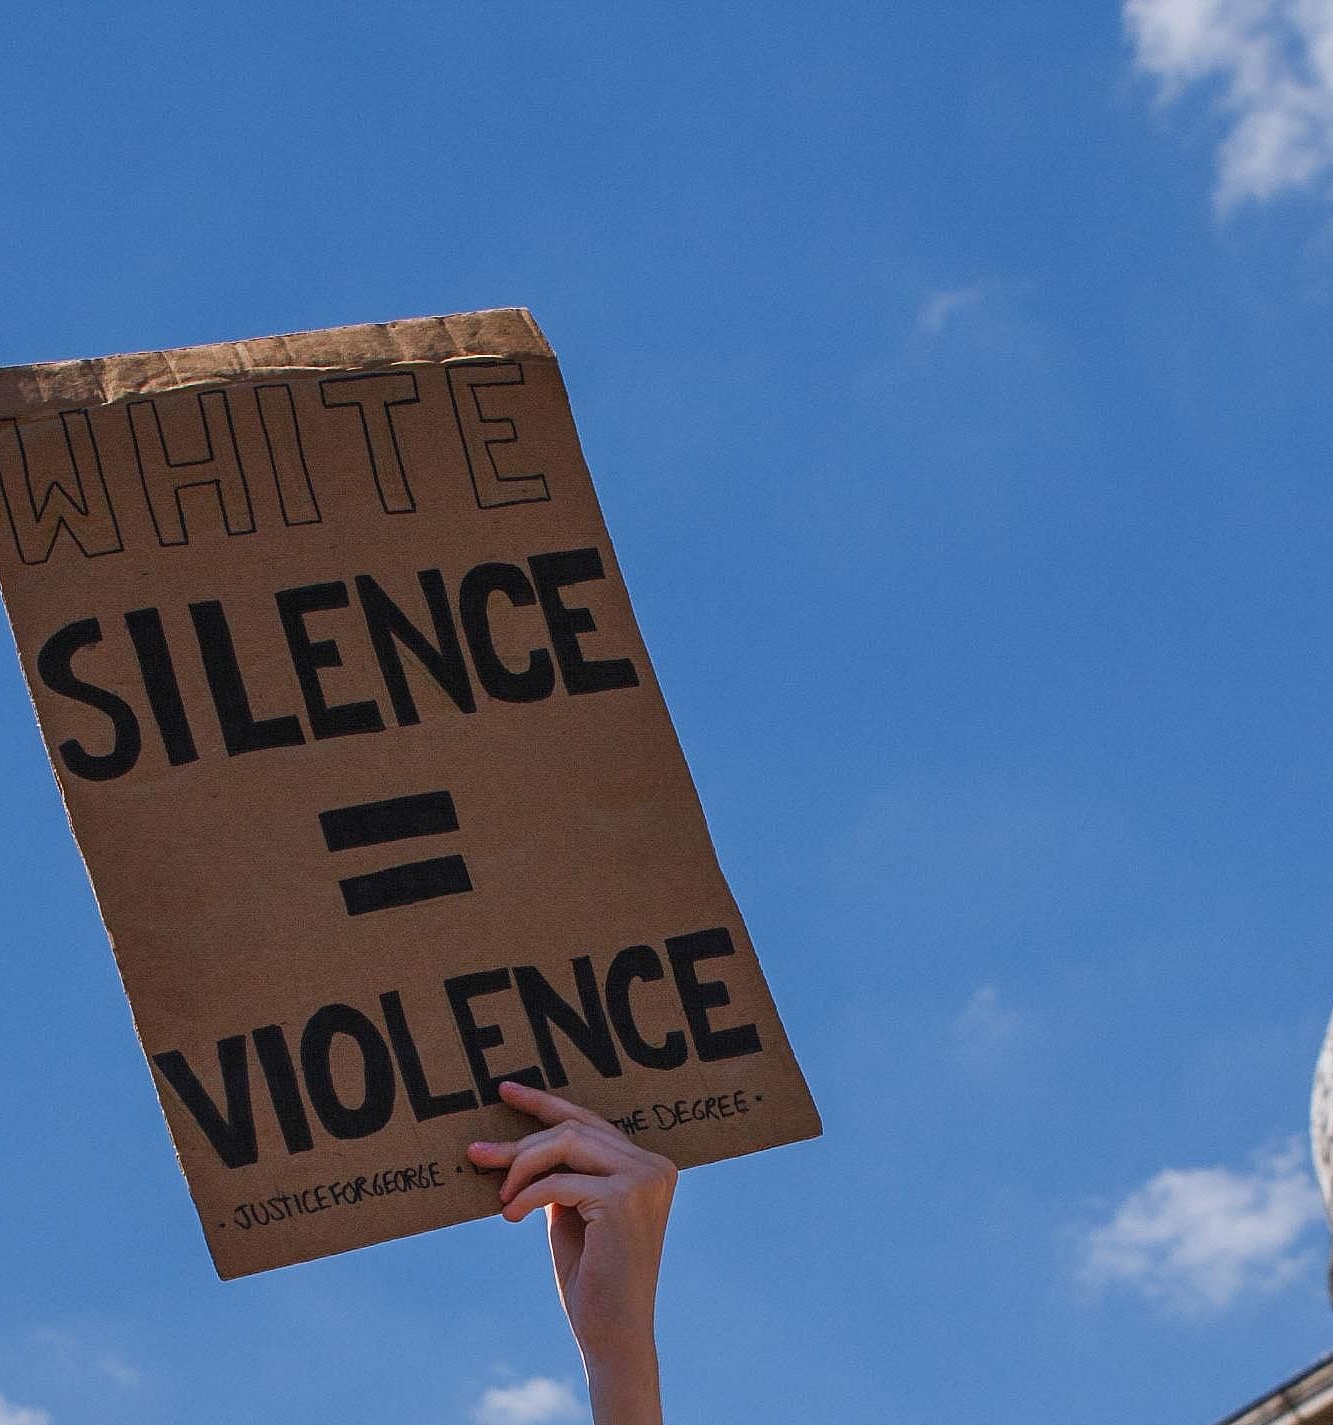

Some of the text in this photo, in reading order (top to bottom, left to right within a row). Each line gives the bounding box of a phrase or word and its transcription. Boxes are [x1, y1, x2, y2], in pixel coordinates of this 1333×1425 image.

[36, 547, 640, 782] SILENCE
[153, 927, 763, 1169] VIOLENCE
[652, 1090, 750, 1130] DEGREE
